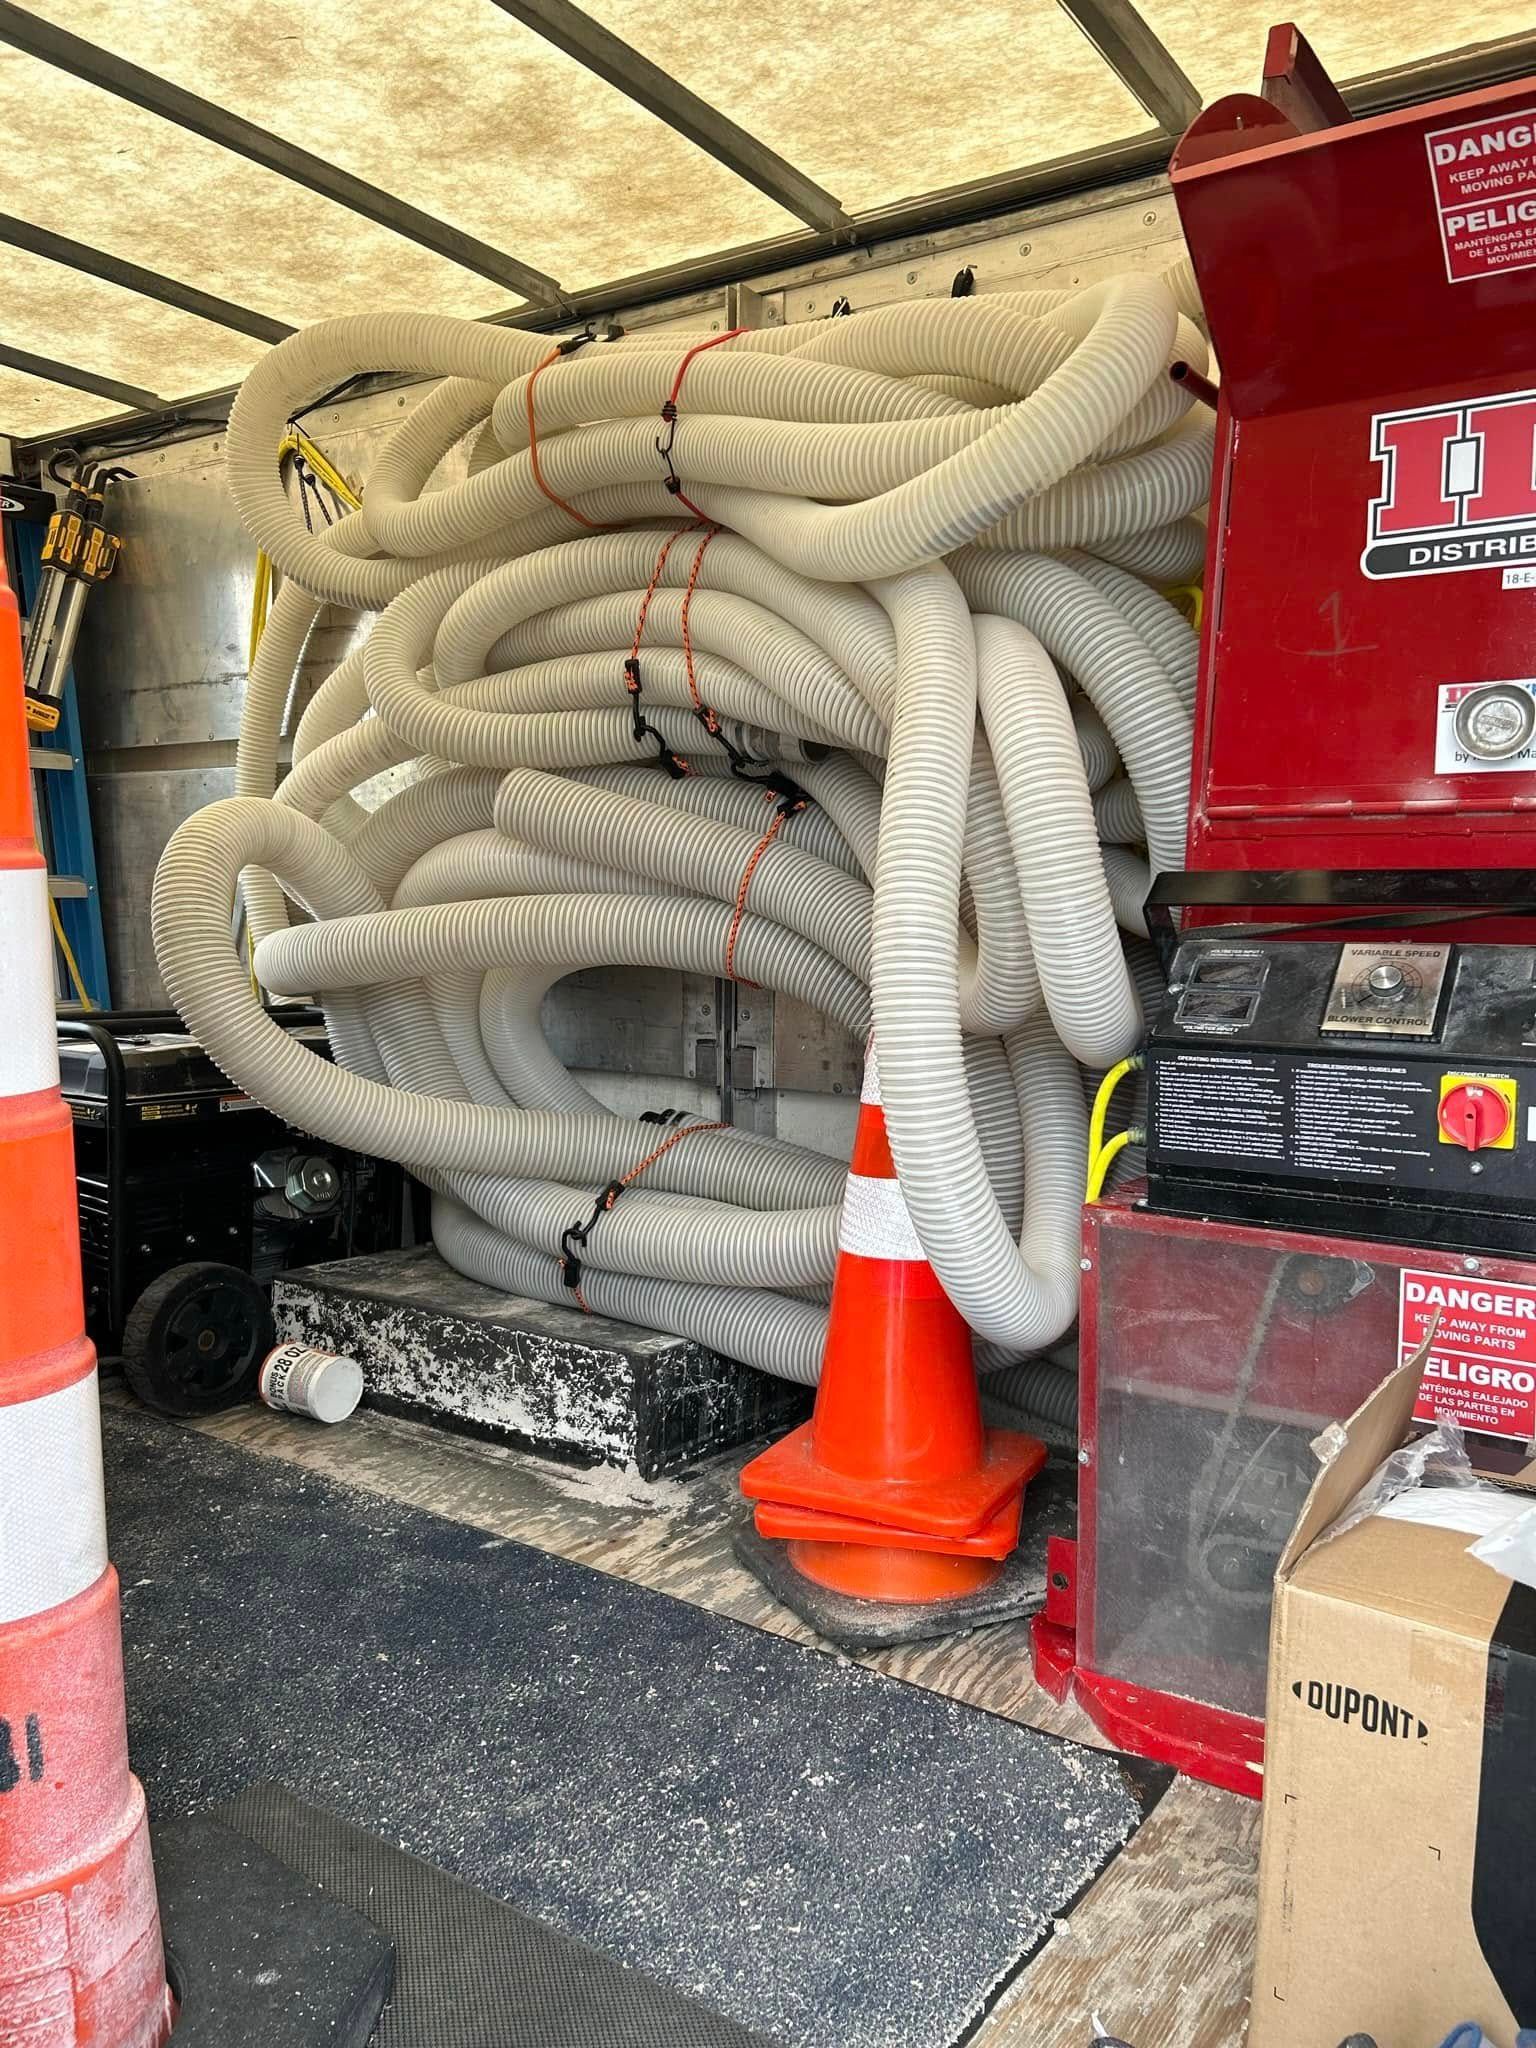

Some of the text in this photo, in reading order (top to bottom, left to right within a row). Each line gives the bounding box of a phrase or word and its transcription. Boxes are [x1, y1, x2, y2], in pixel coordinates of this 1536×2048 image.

[1434, 122, 1536, 166] DANG
[1450, 167, 1484, 183] KEEP
[1489, 157, 1529, 175] AWAY
[1461, 174, 1514, 194] MOVING
[1469, 248, 1484, 258] DE
[1486, 244, 1508, 255] LAS
[1455, 751, 1469, 763] by
[1351, 949, 1402, 957] VARIABLE
[1327, 1015, 1430, 1026] BLOWER CONTROL
[1405, 1282, 1536, 1320] DANGER
[1414, 1313, 1527, 1339] KEP AWAY FROM
[1474, 1333, 1516, 1350] PARTS
[274, 1358, 293, 1373] 28
[1405, 1353, 1535, 1393] ELIGRO
[1419, 1393, 1515, 1417] DE LAS PARTES EN
[1473, 1391, 1529, 1409] EALEJADO
[1434, 1406, 1499, 1424] MOVIMIENTO
[1307, 1680, 1414, 1739] DUPONT
